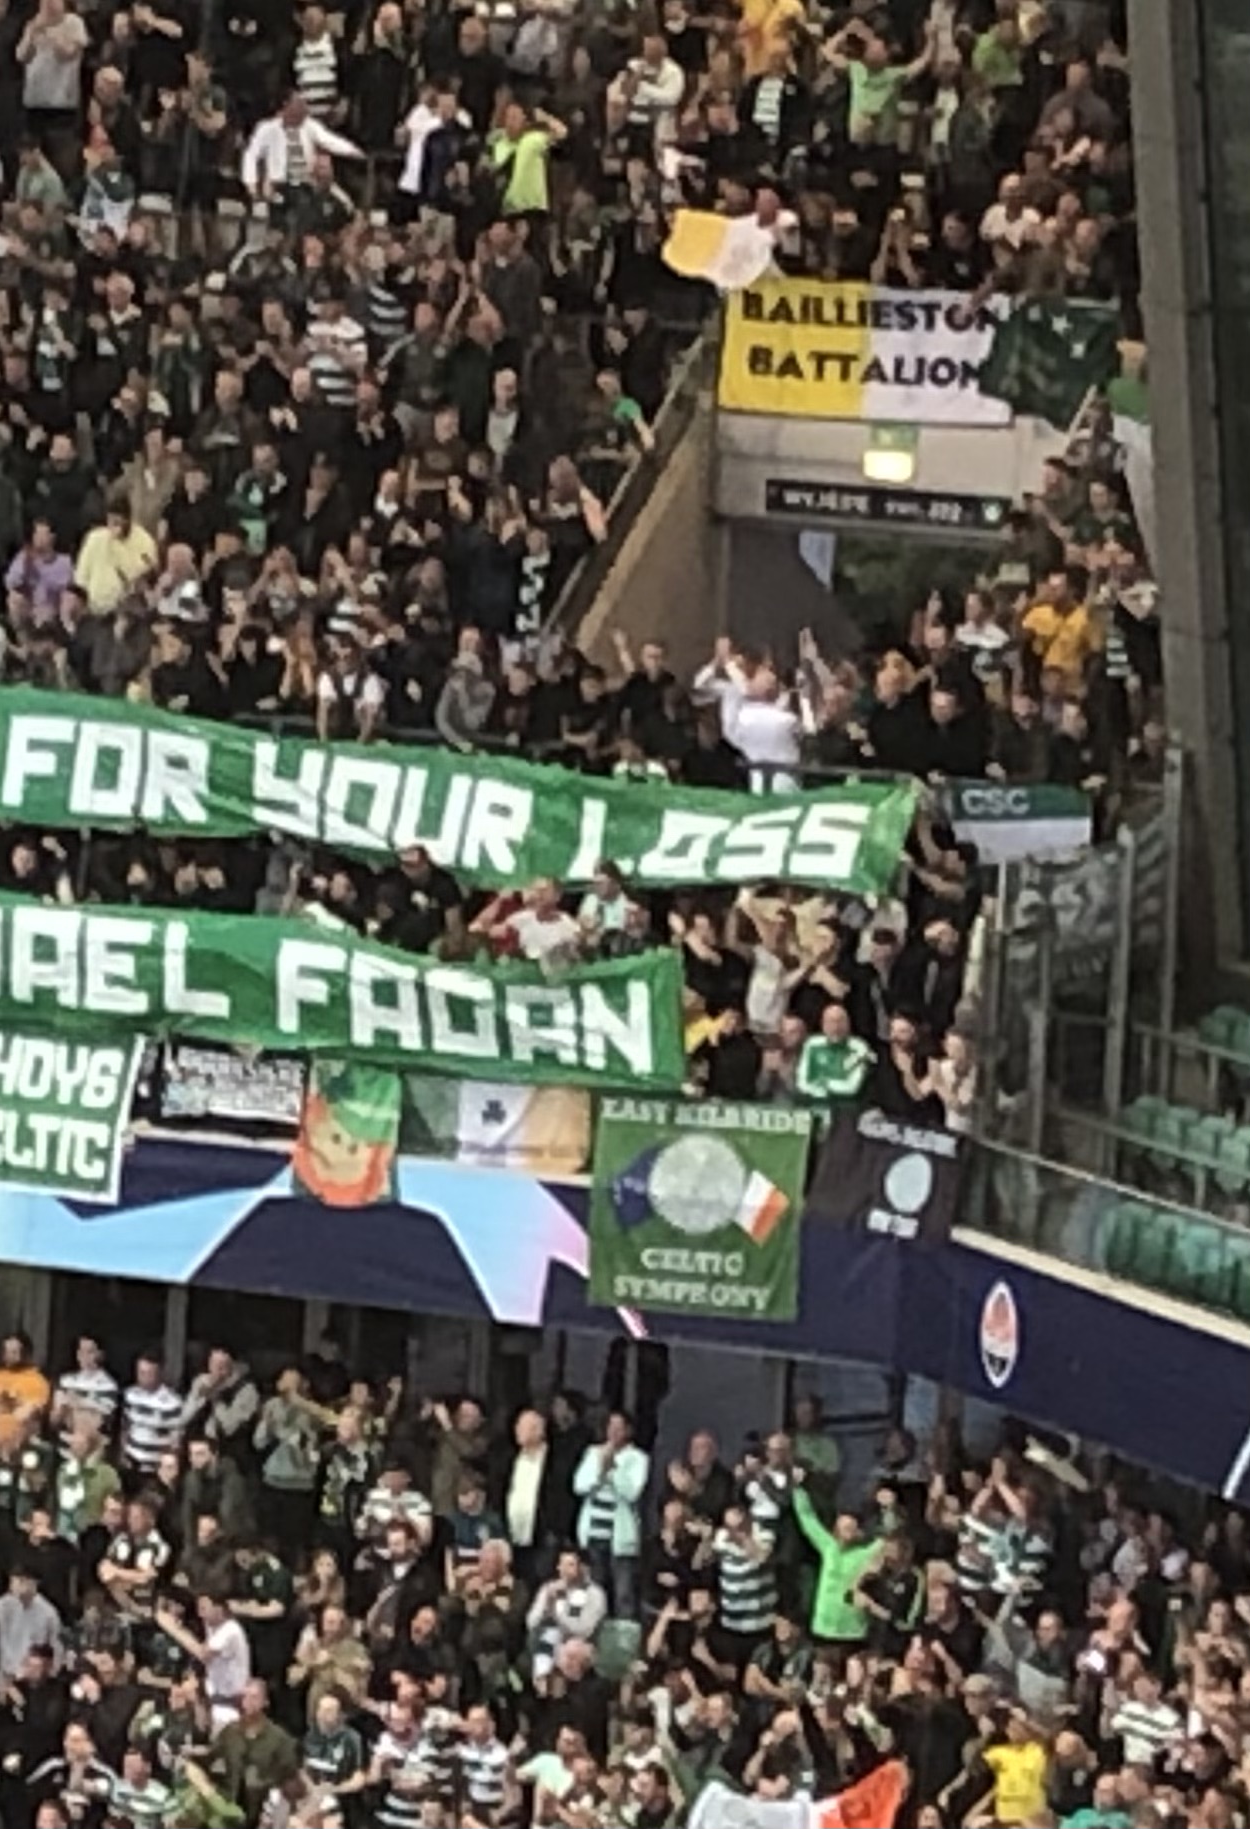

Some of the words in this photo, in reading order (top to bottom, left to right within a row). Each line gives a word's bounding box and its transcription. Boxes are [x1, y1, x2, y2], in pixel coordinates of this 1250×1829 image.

[1, 714, 211, 824] FOR
[252, 740, 534, 875] YOUR
[566, 797, 870, 879] LOSS
[961, 788, 1030, 815] CSC
[640, 1247, 744, 1278] CELTIC
[614, 1274, 771, 1311] SYMPHONY
